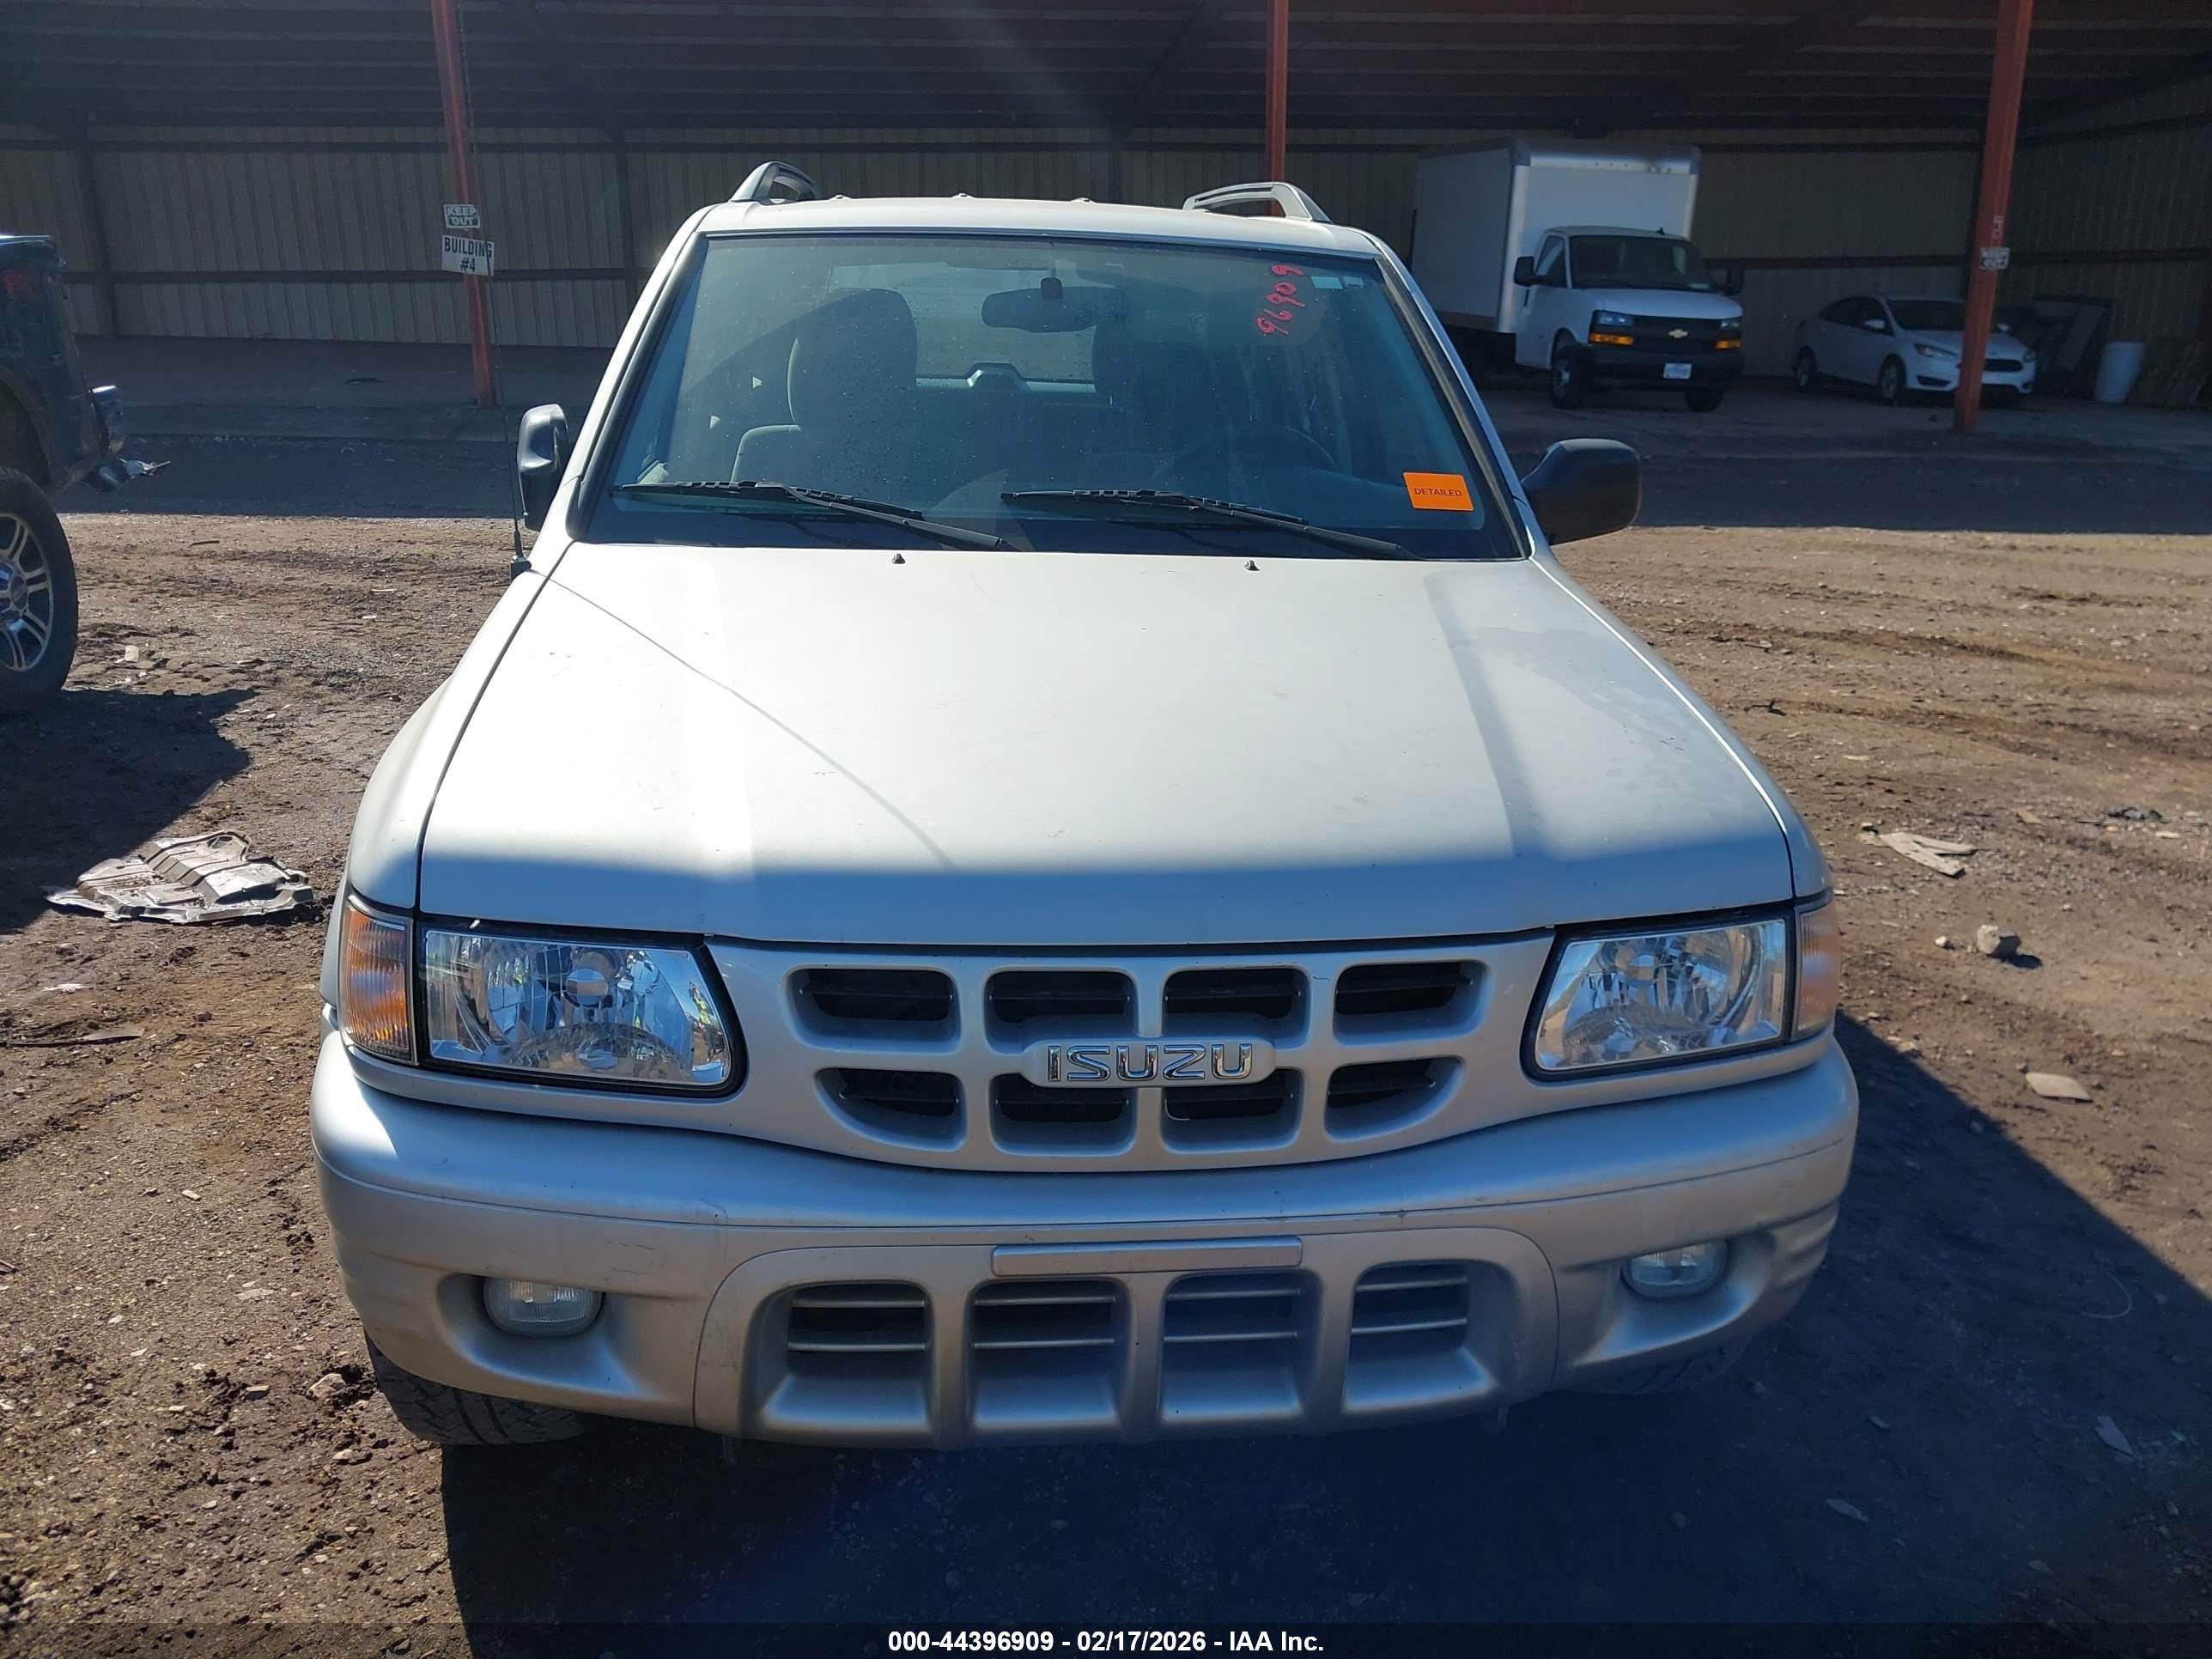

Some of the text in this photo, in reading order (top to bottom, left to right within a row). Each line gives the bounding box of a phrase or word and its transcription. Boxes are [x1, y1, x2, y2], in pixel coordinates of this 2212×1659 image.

[447, 207, 476, 216] KEEP
[451, 216, 475, 226] OUT
[444, 237, 493, 258] BUILDING
[459, 258, 476, 272] #4
[1414, 488, 1462, 496] DETAILED
[1048, 1043, 1253, 1082] ISUZU
